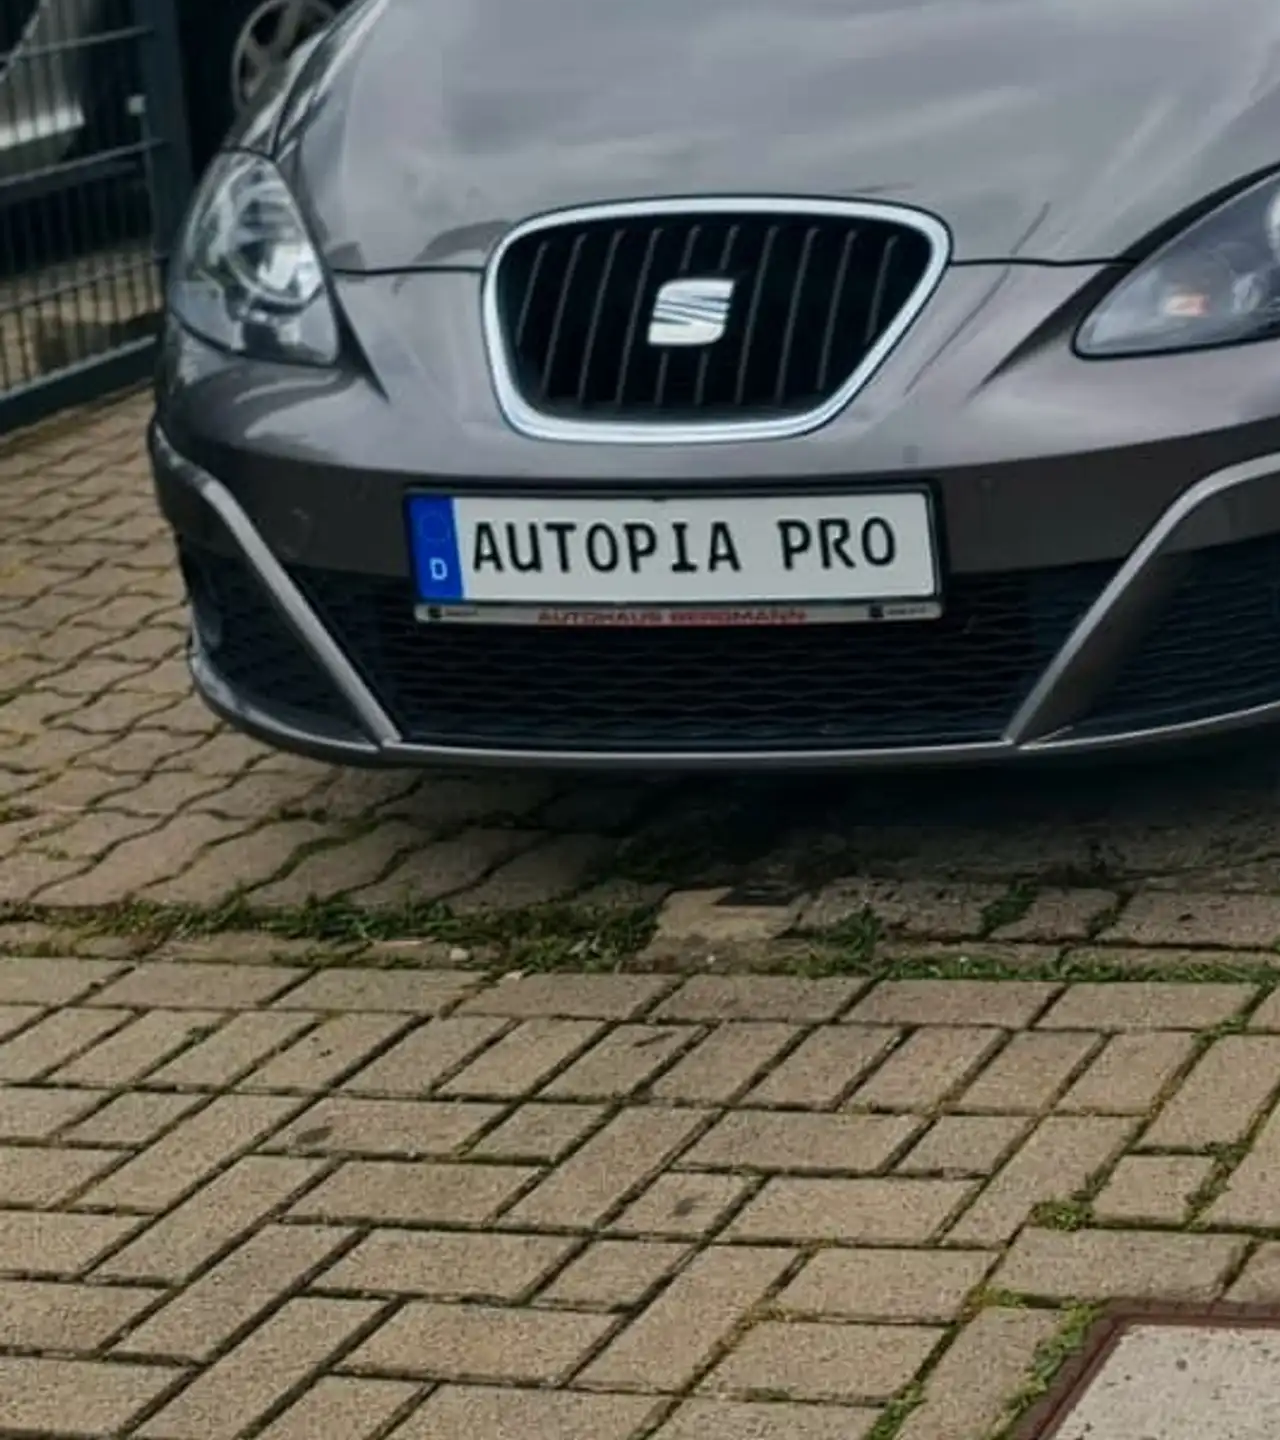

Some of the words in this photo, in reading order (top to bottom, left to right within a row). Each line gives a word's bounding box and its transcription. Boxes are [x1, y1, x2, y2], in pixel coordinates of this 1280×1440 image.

[473, 521, 742, 574] AUTOPIA
[777, 516, 897, 572] PRO
[430, 558, 450, 581] D
